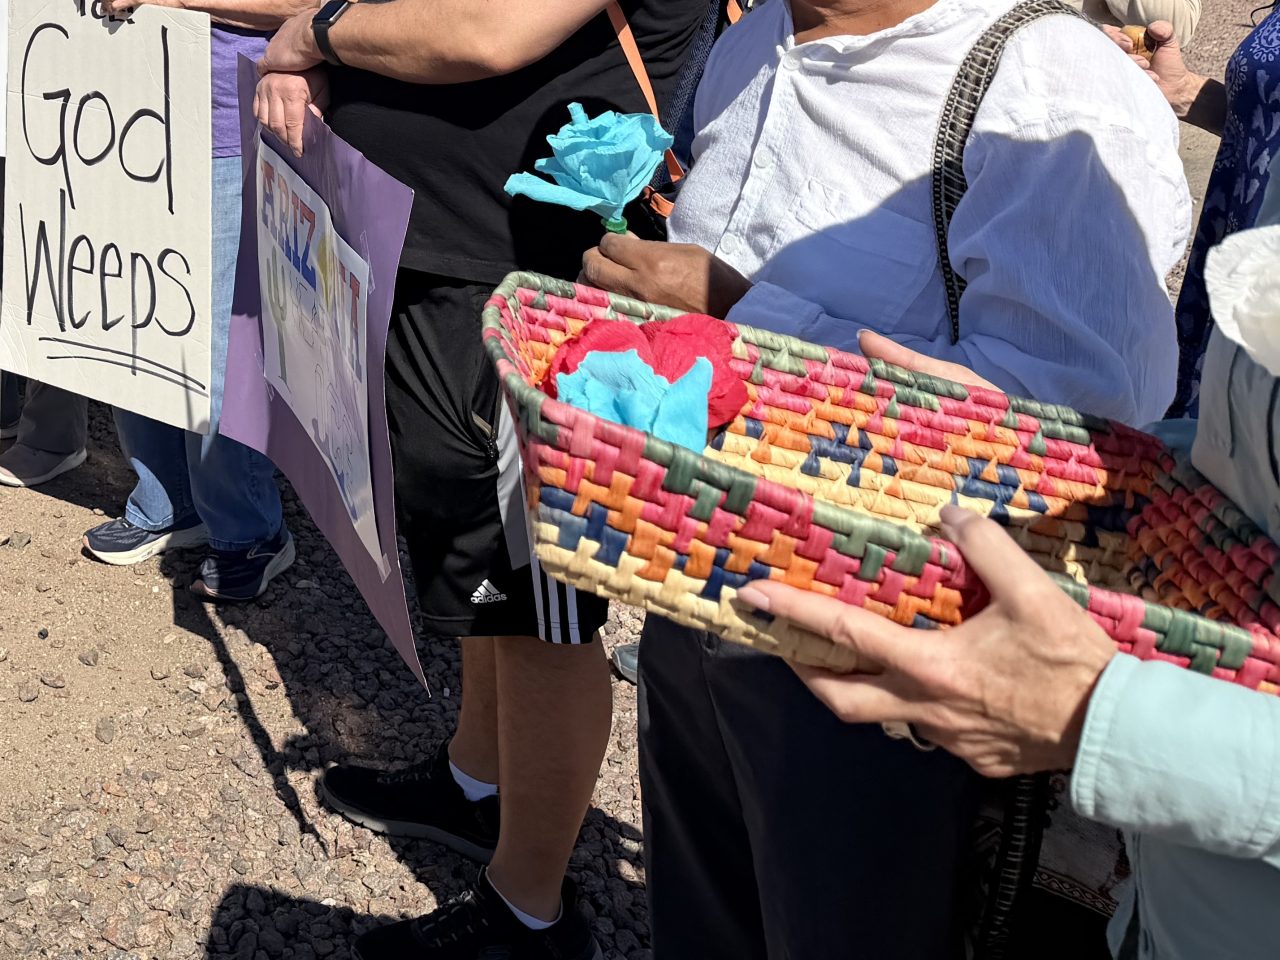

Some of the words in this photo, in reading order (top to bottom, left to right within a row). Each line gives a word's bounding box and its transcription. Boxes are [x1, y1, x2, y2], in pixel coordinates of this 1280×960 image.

[20, 21, 174, 214] God
[18, 187, 196, 376] Weeps
[471, 593, 507, 603] adidas
